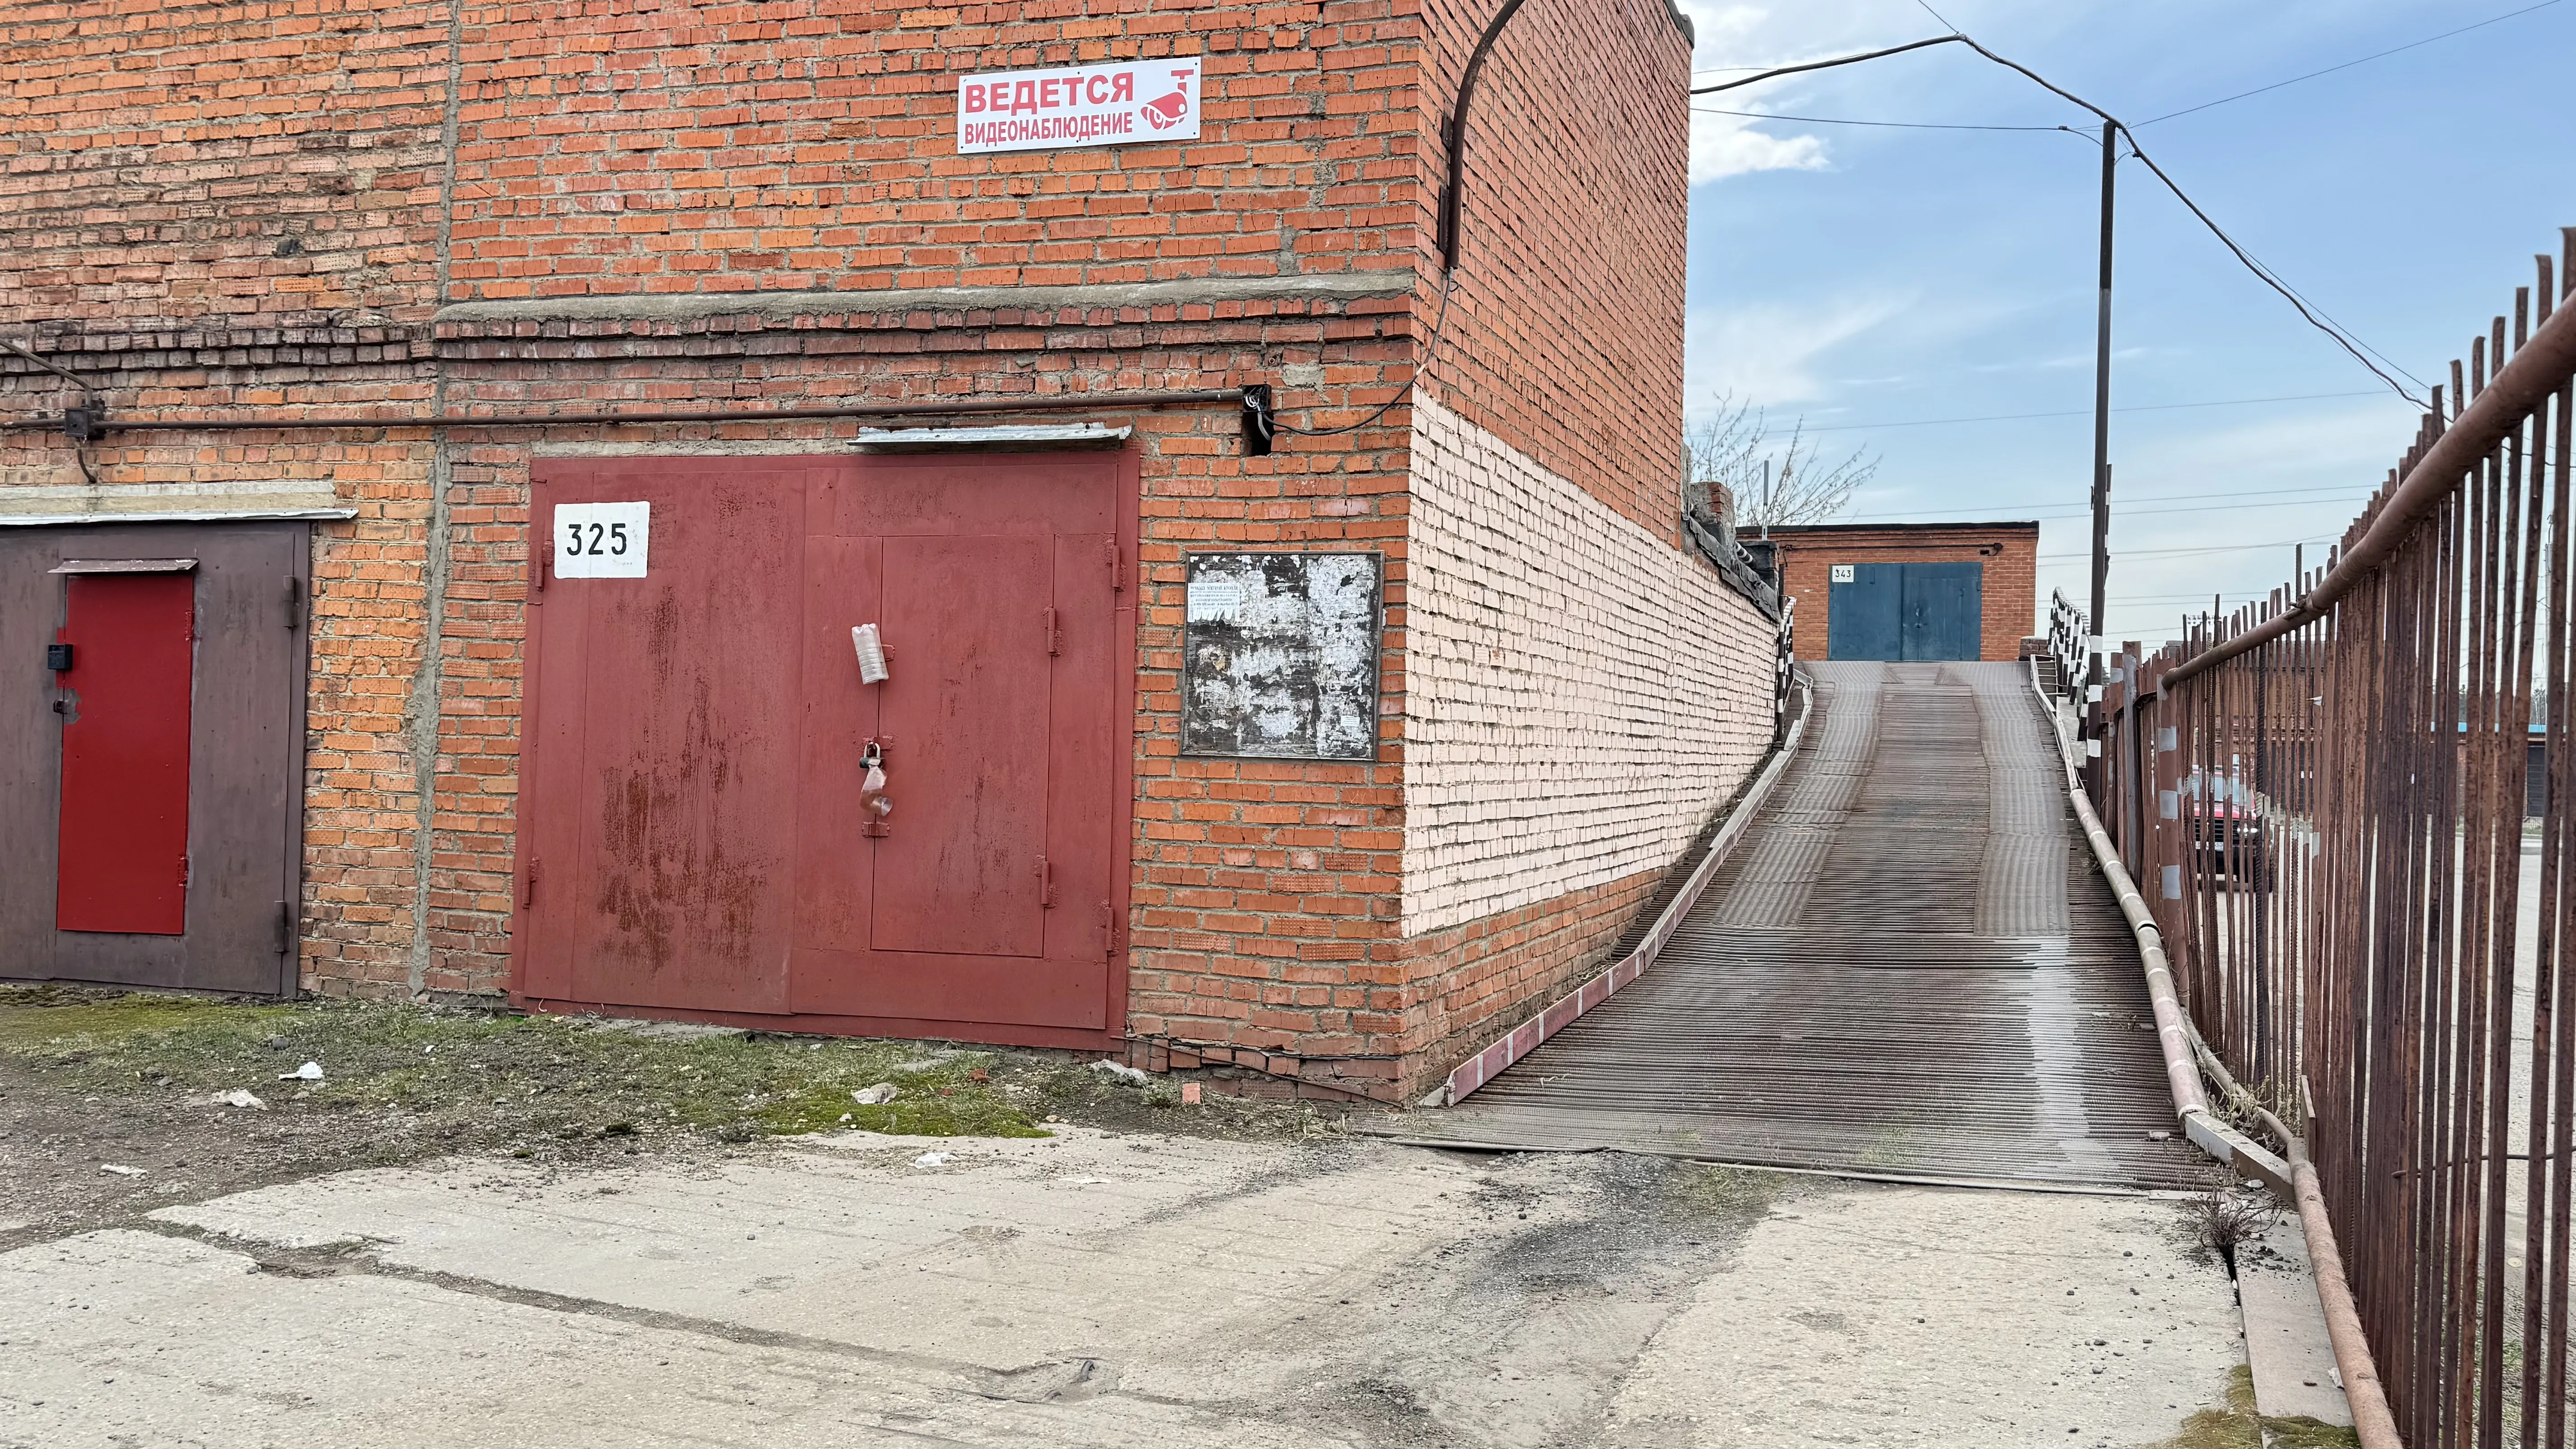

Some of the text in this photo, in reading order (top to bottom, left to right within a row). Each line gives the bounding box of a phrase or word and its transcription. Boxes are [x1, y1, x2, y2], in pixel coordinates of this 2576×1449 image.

[965, 72, 1133, 116] ВЕДЕТСЯ
[965, 112, 1133, 147] ВИДЕОНАБЛЮДЕНИЕ
[567, 523, 626, 556] 325
[1835, 569, 1851, 577] 343
